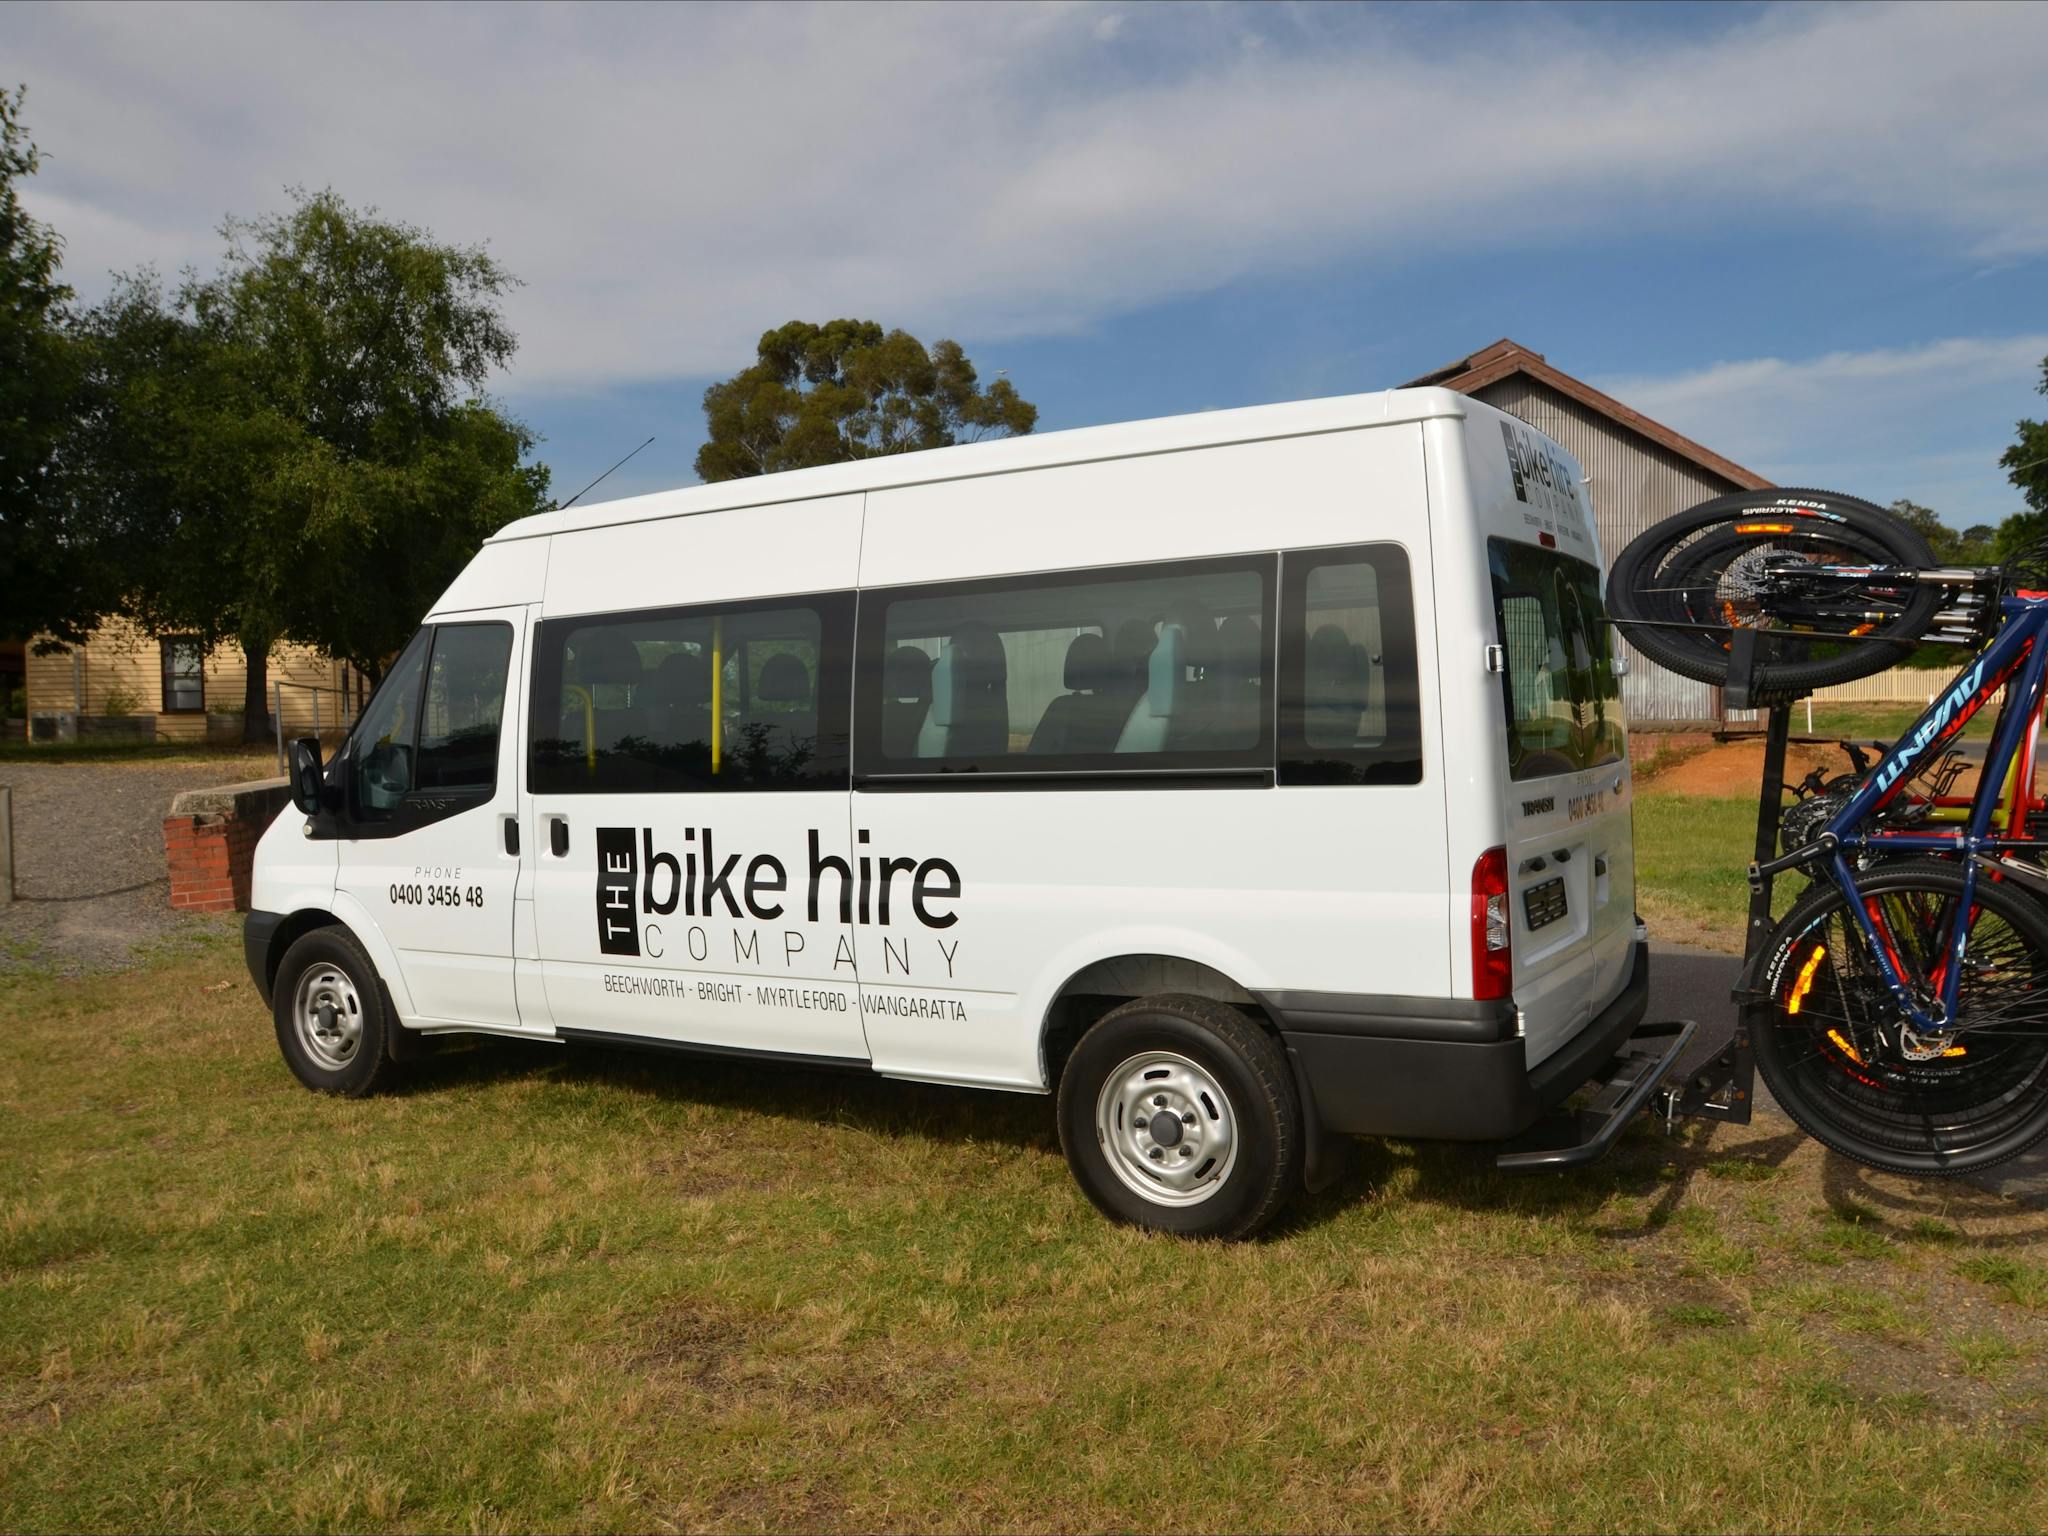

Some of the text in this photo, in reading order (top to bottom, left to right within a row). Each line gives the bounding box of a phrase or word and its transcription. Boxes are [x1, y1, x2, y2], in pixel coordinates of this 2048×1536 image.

[1512, 425, 1575, 500] bike hire
[1776, 499, 1827, 510] KENDA
[1521, 796, 1555, 817] TRANSIT
[390, 883, 484, 908] 0400 3456 48
[414, 866, 462, 879] PHONE
[643, 827, 961, 929] bike hire
[606, 852, 631, 941] THE
[645, 924, 958, 978] COMPANY
[1766, 936, 1792, 980] KENDA
[604, 974, 685, 998] BEECHWORTH
[698, 981, 742, 1003] BRIGHT
[756, 986, 847, 1012] MYRTLEFORD
[861, 994, 967, 1022] WANGARATTA
